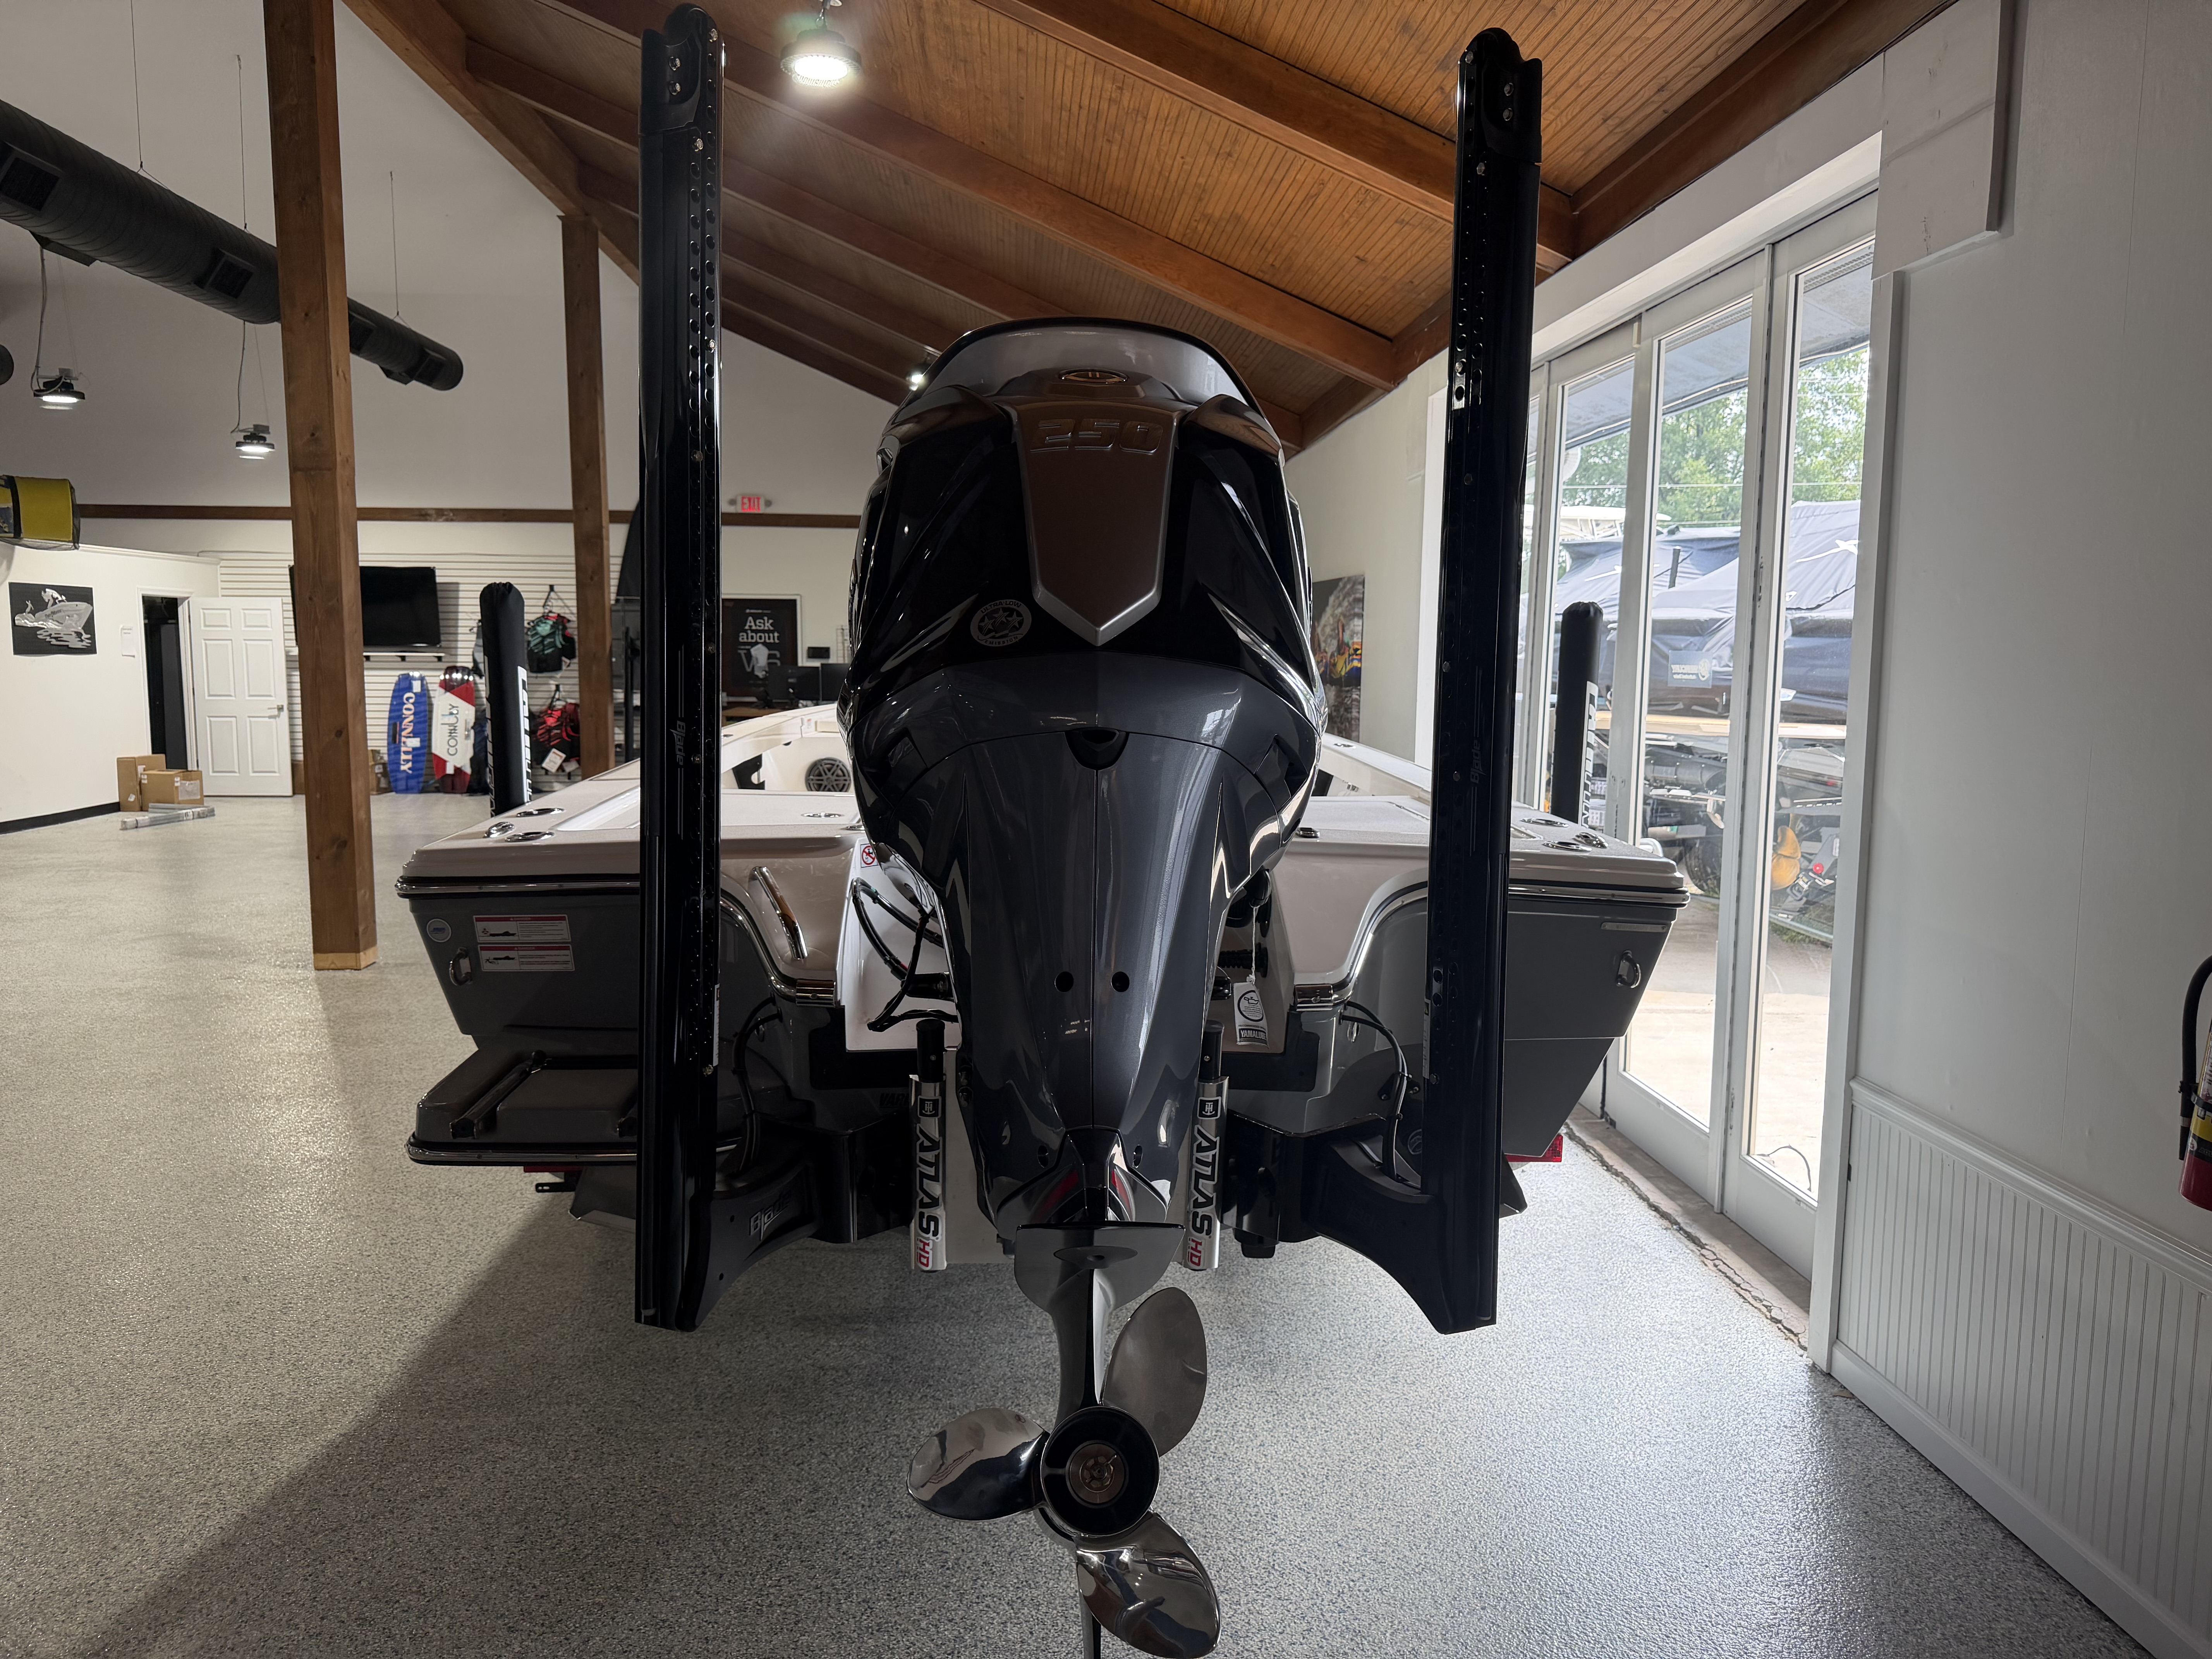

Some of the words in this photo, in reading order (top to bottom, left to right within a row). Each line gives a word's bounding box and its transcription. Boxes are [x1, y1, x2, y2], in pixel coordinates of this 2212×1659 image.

[1030, 418, 1163, 455] 250
[741, 496, 761, 512] EXIT
[738, 630, 780, 643] about
[744, 616, 774, 630] Ask
[985, 636, 1018, 645] EMISSION
[669, 720, 685, 765] Blade
[1470, 740, 1487, 783] Blade
[917, 1124, 941, 1238] ATLAS
[1192, 1125, 1218, 1237] ATLAS
[917, 1239, 930, 1269] HD
[1188, 1238, 1203, 1267] HD
